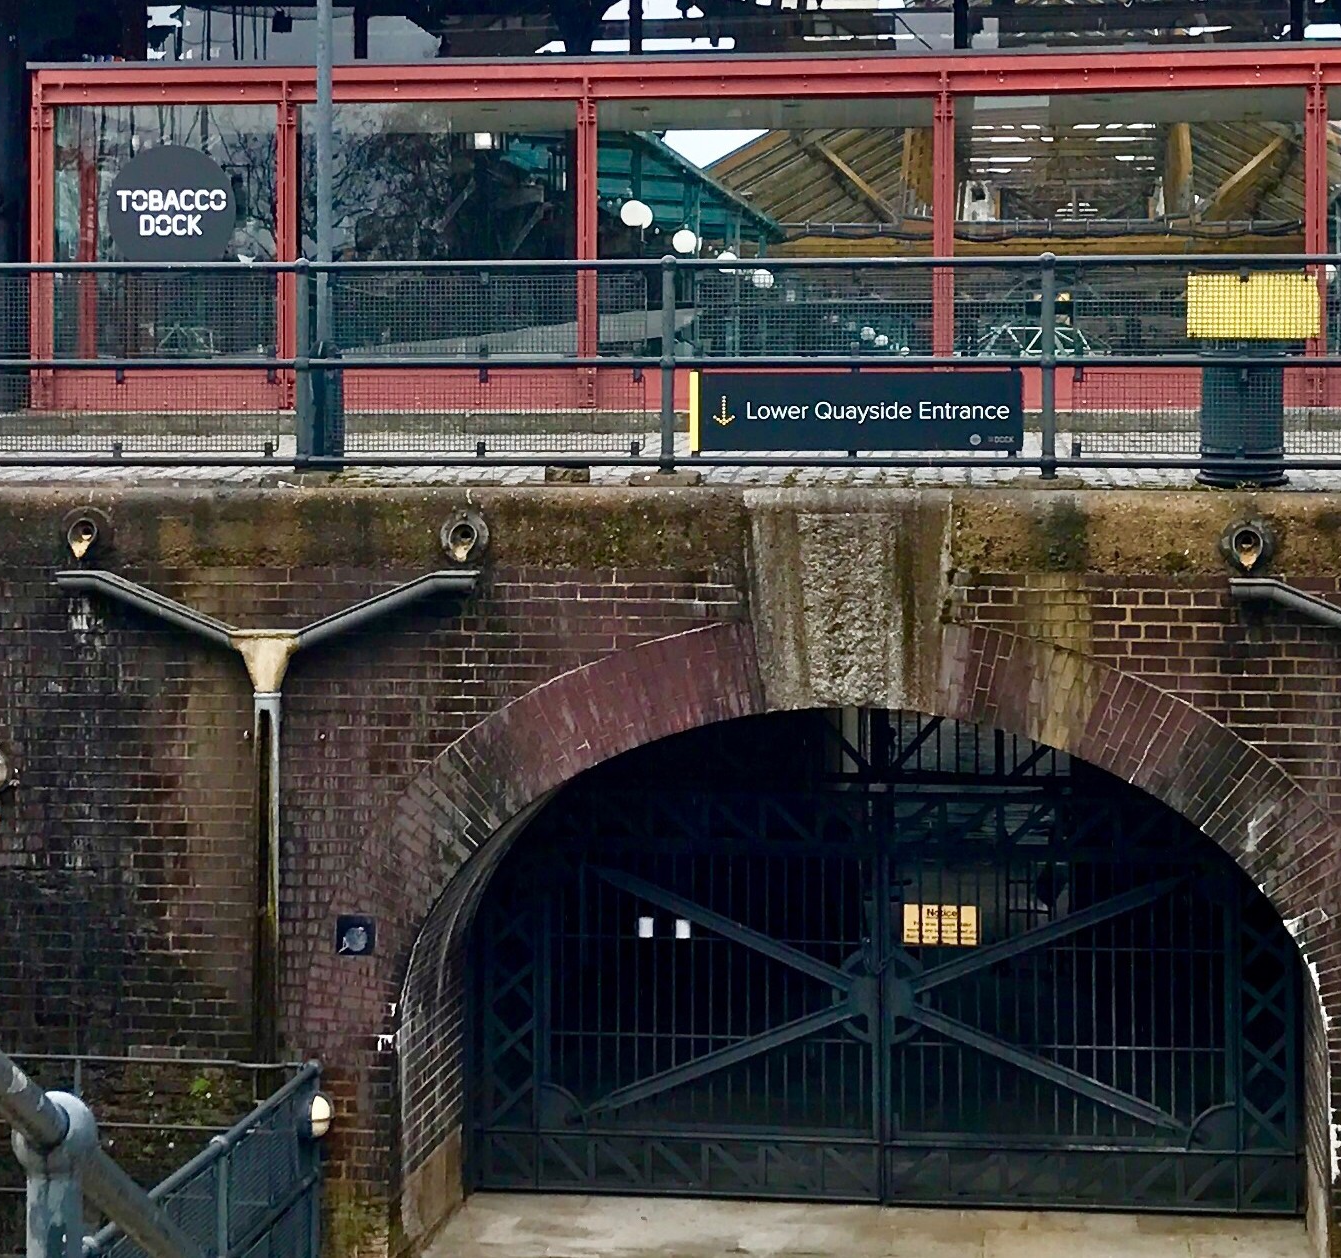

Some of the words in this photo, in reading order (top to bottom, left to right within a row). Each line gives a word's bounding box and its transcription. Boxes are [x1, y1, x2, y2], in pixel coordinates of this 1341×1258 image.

[116, 189, 227, 212] TOBACCO
[139, 214, 203, 236] DOCK
[746, 401, 809, 420] Lower
[814, 401, 913, 424] Quayside
[919, 401, 1010, 420] Entrance
[926, 908, 959, 916] Noice
